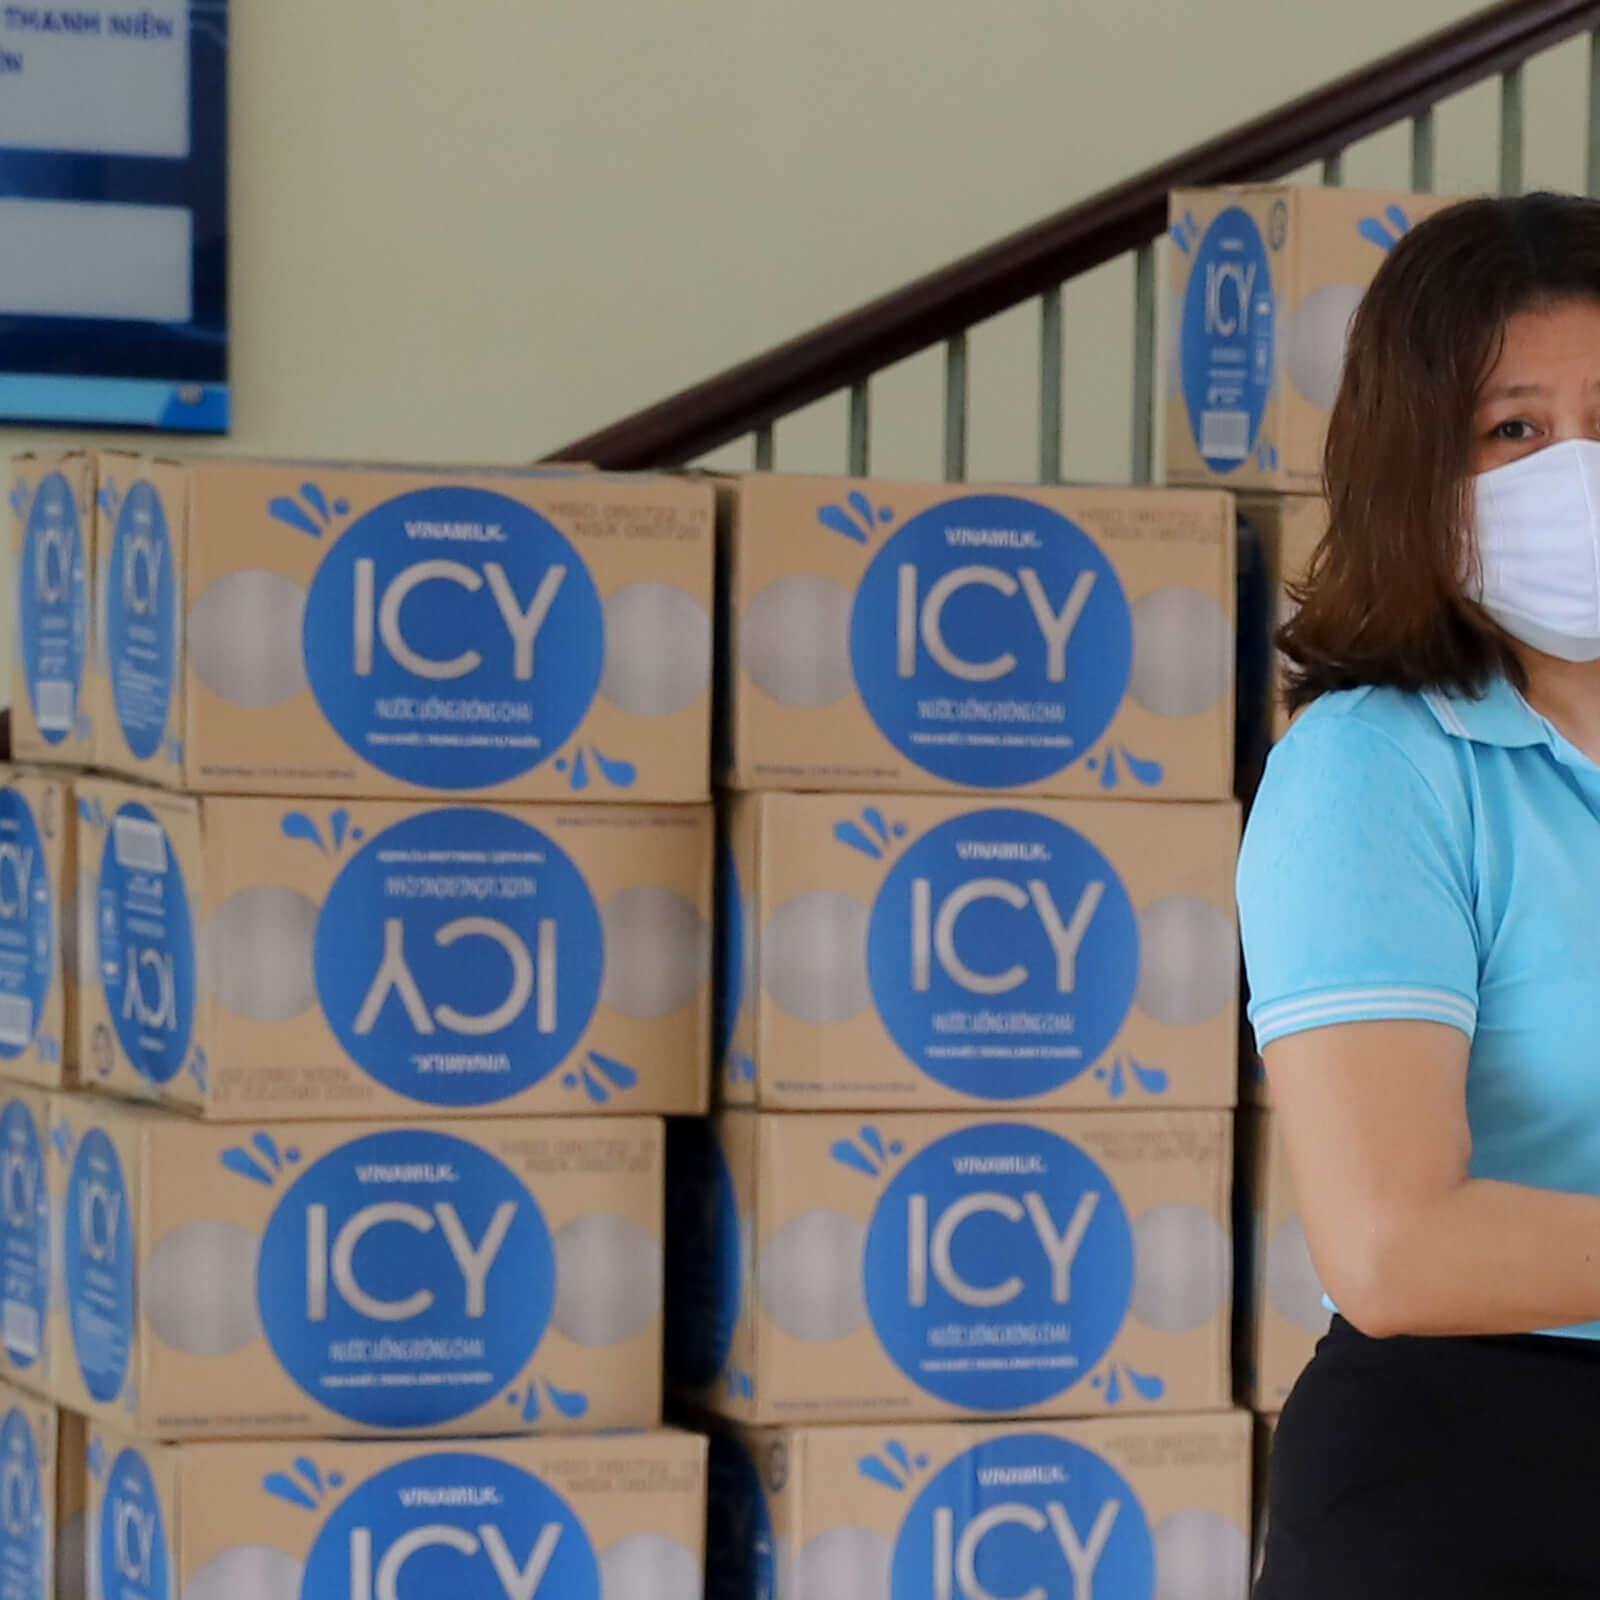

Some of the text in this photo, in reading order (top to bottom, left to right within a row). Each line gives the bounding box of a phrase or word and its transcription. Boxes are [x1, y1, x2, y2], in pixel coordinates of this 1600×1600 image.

[1204, 262, 1256, 337] ICY
[405, 522, 504, 542] VINAMILK
[945, 528, 1038, 548] VINAMILK
[123, 535, 161, 616] ICY
[354, 558, 567, 680] ICY
[898, 564, 1097, 682] ICY
[957, 841, 1049, 861] VINAMILK
[354, 916, 557, 1035] ICY
[912, 878, 1105, 995] ICY
[123, 945, 176, 1032] ICY
[415, 1054, 510, 1072] VINAMILK
[357, 1163, 456, 1183] VINAMILK
[953, 1155, 1044, 1174] VINAMILK
[307, 1201, 517, 1321] ICY
[908, 1192, 1100, 1307] ICY
[400, 1486, 500, 1506] VINAMILK
[979, 1465, 1066, 1486] VINAMILK
[114, 1497, 155, 1584] ICY
